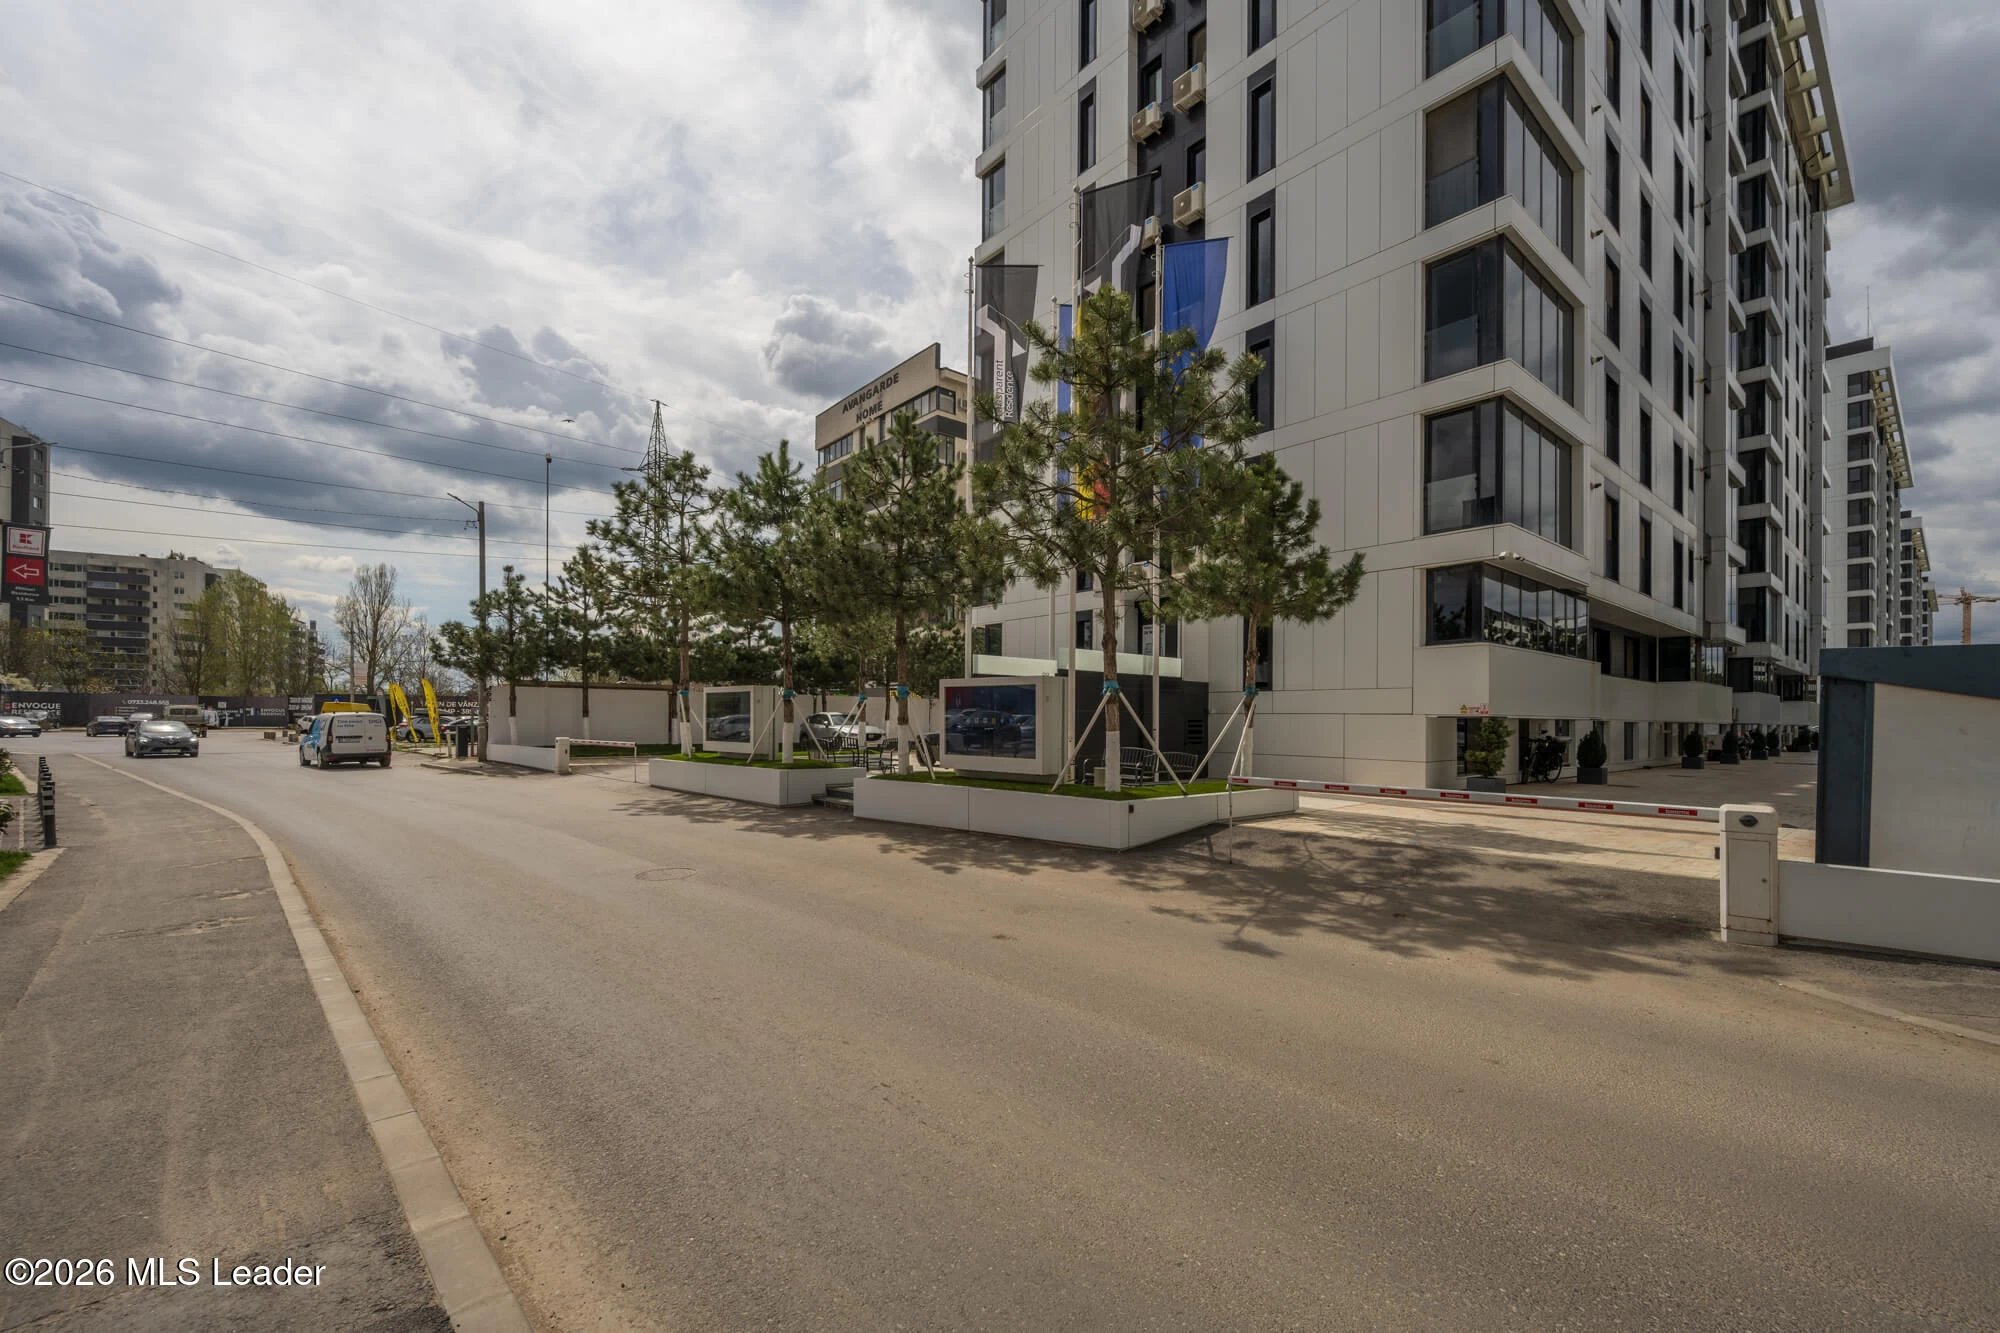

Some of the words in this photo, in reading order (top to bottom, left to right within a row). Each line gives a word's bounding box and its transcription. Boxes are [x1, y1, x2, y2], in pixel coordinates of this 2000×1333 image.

[842, 372, 900, 414] AVANGARDE
[1004, 370, 1014, 418] Residence
[856, 400, 883, 423] HOME
[11, 702, 61, 710] ENVOGUE
[458, 700, 479, 708] VÂNZ
